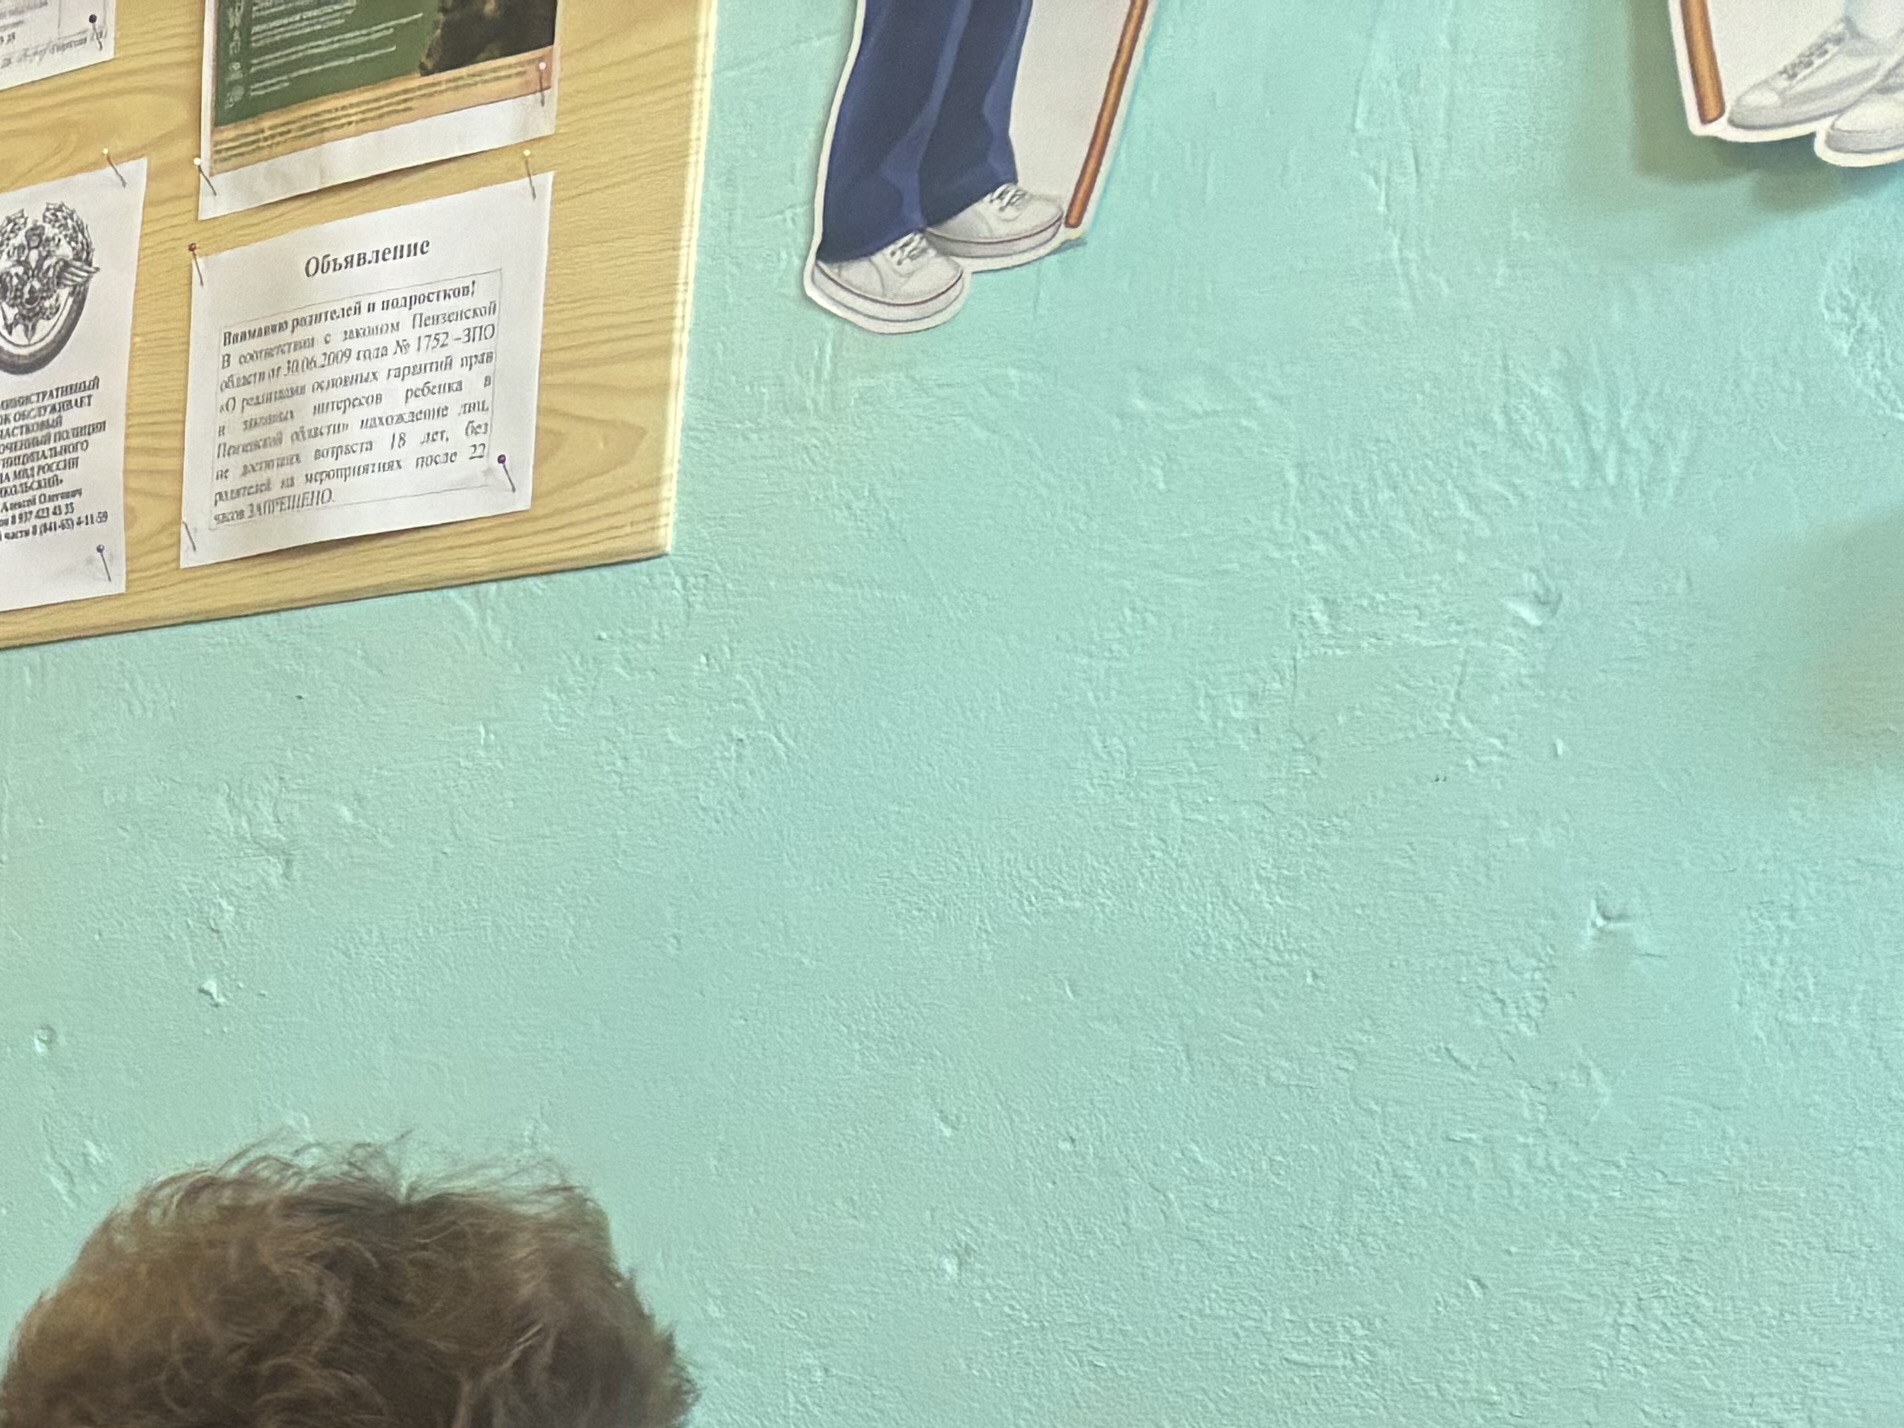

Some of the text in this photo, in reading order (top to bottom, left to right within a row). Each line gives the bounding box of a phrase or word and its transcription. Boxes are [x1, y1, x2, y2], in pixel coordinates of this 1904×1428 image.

[304, 238, 431, 279] Объявление
[290, 303, 361, 333] родителей
[221, 352, 231, 368] В
[411, 297, 497, 331] Пензенской
[415, 330, 448, 352] 1752
[390, 430, 406, 449] 18
[468, 441, 486, 460] 22
